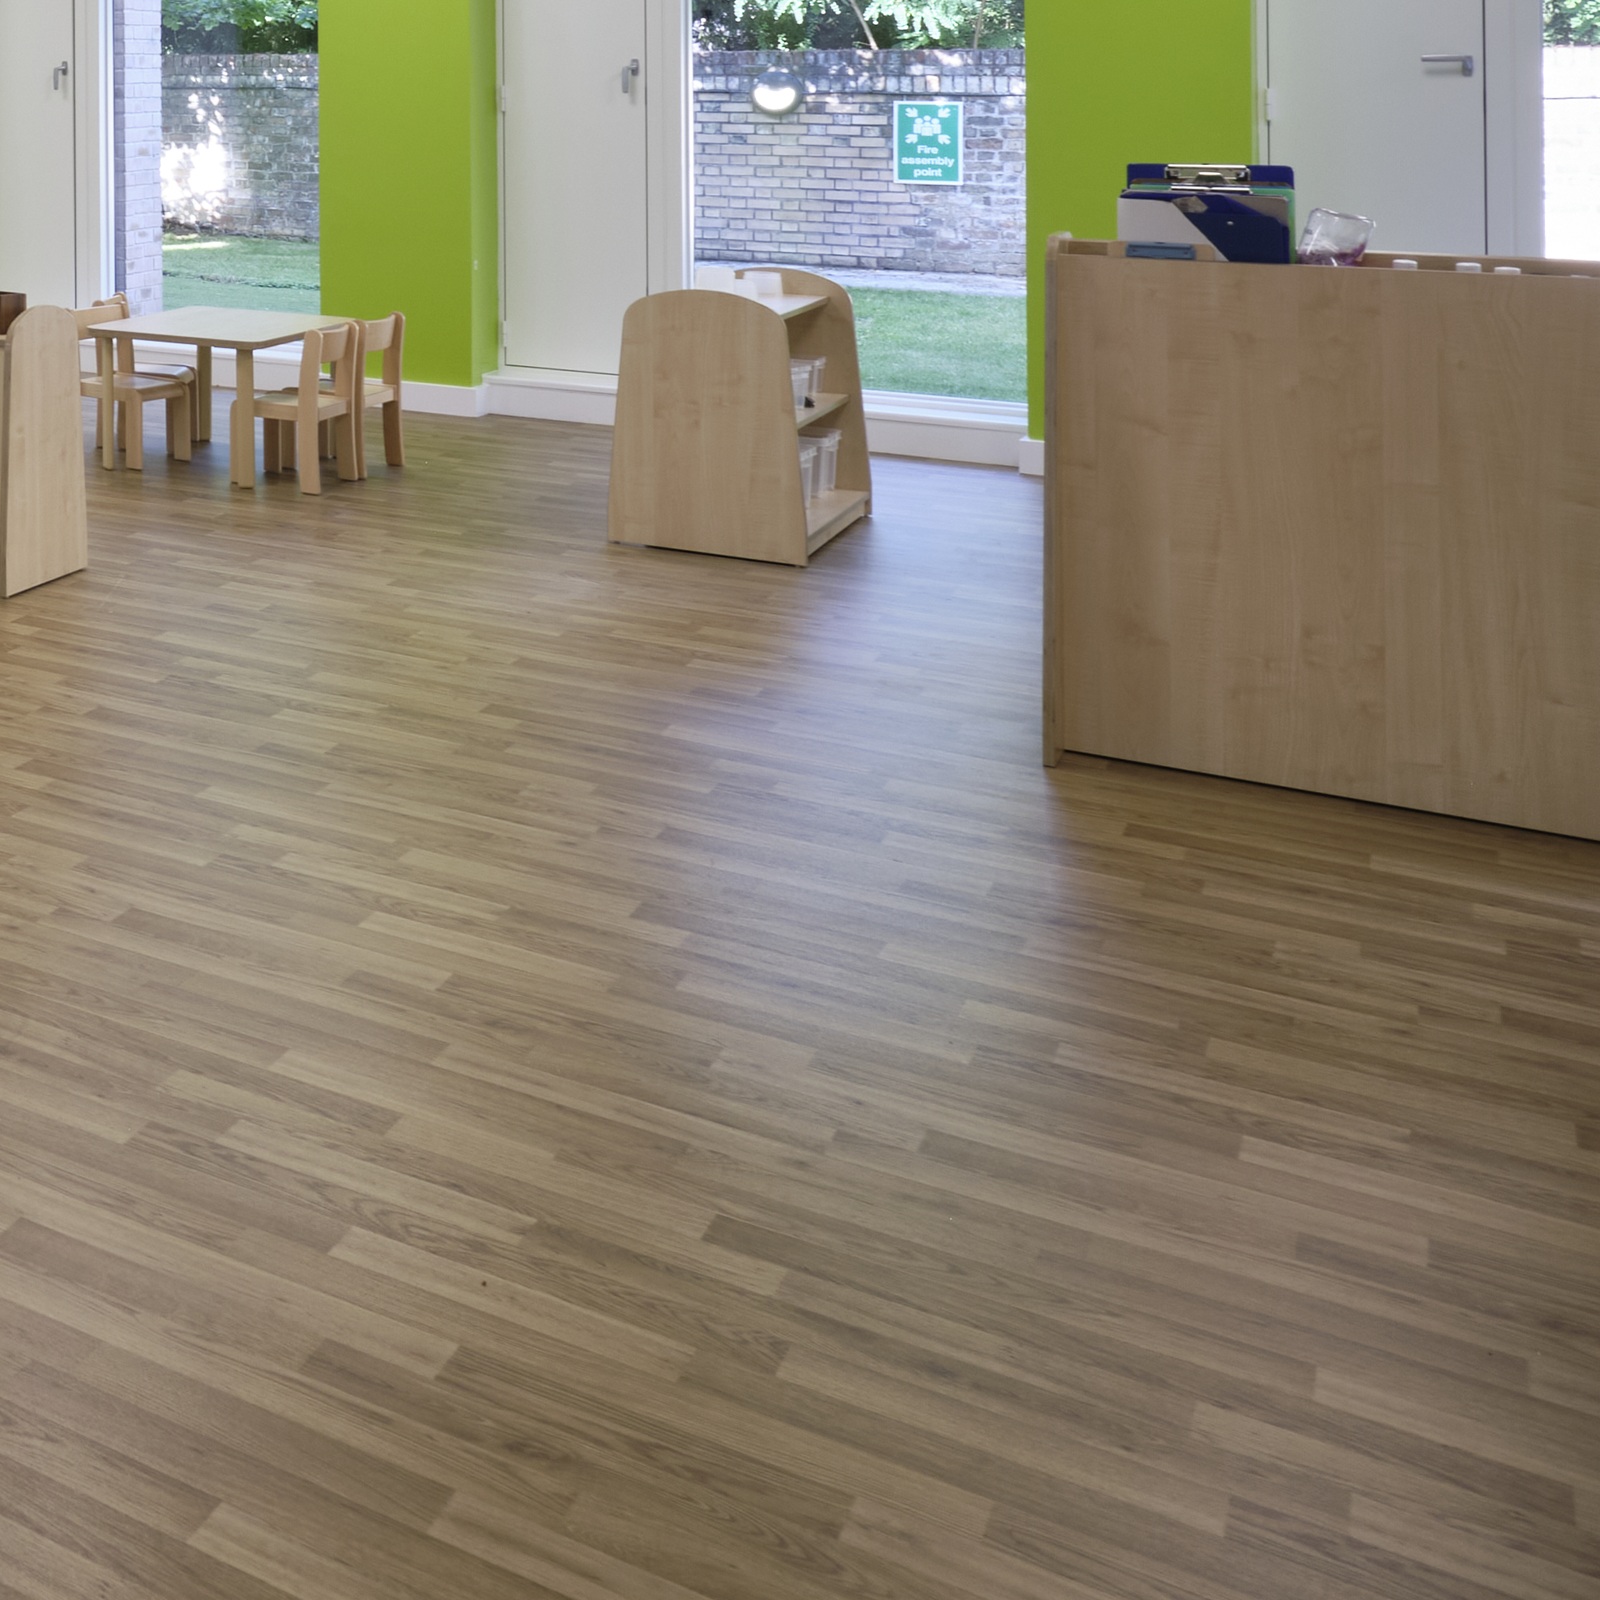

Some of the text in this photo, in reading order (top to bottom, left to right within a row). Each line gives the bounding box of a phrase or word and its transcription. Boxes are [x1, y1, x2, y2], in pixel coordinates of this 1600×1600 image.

[917, 145, 939, 154] Fire
[901, 156, 955, 168] assembly
[913, 167, 942, 178] point
